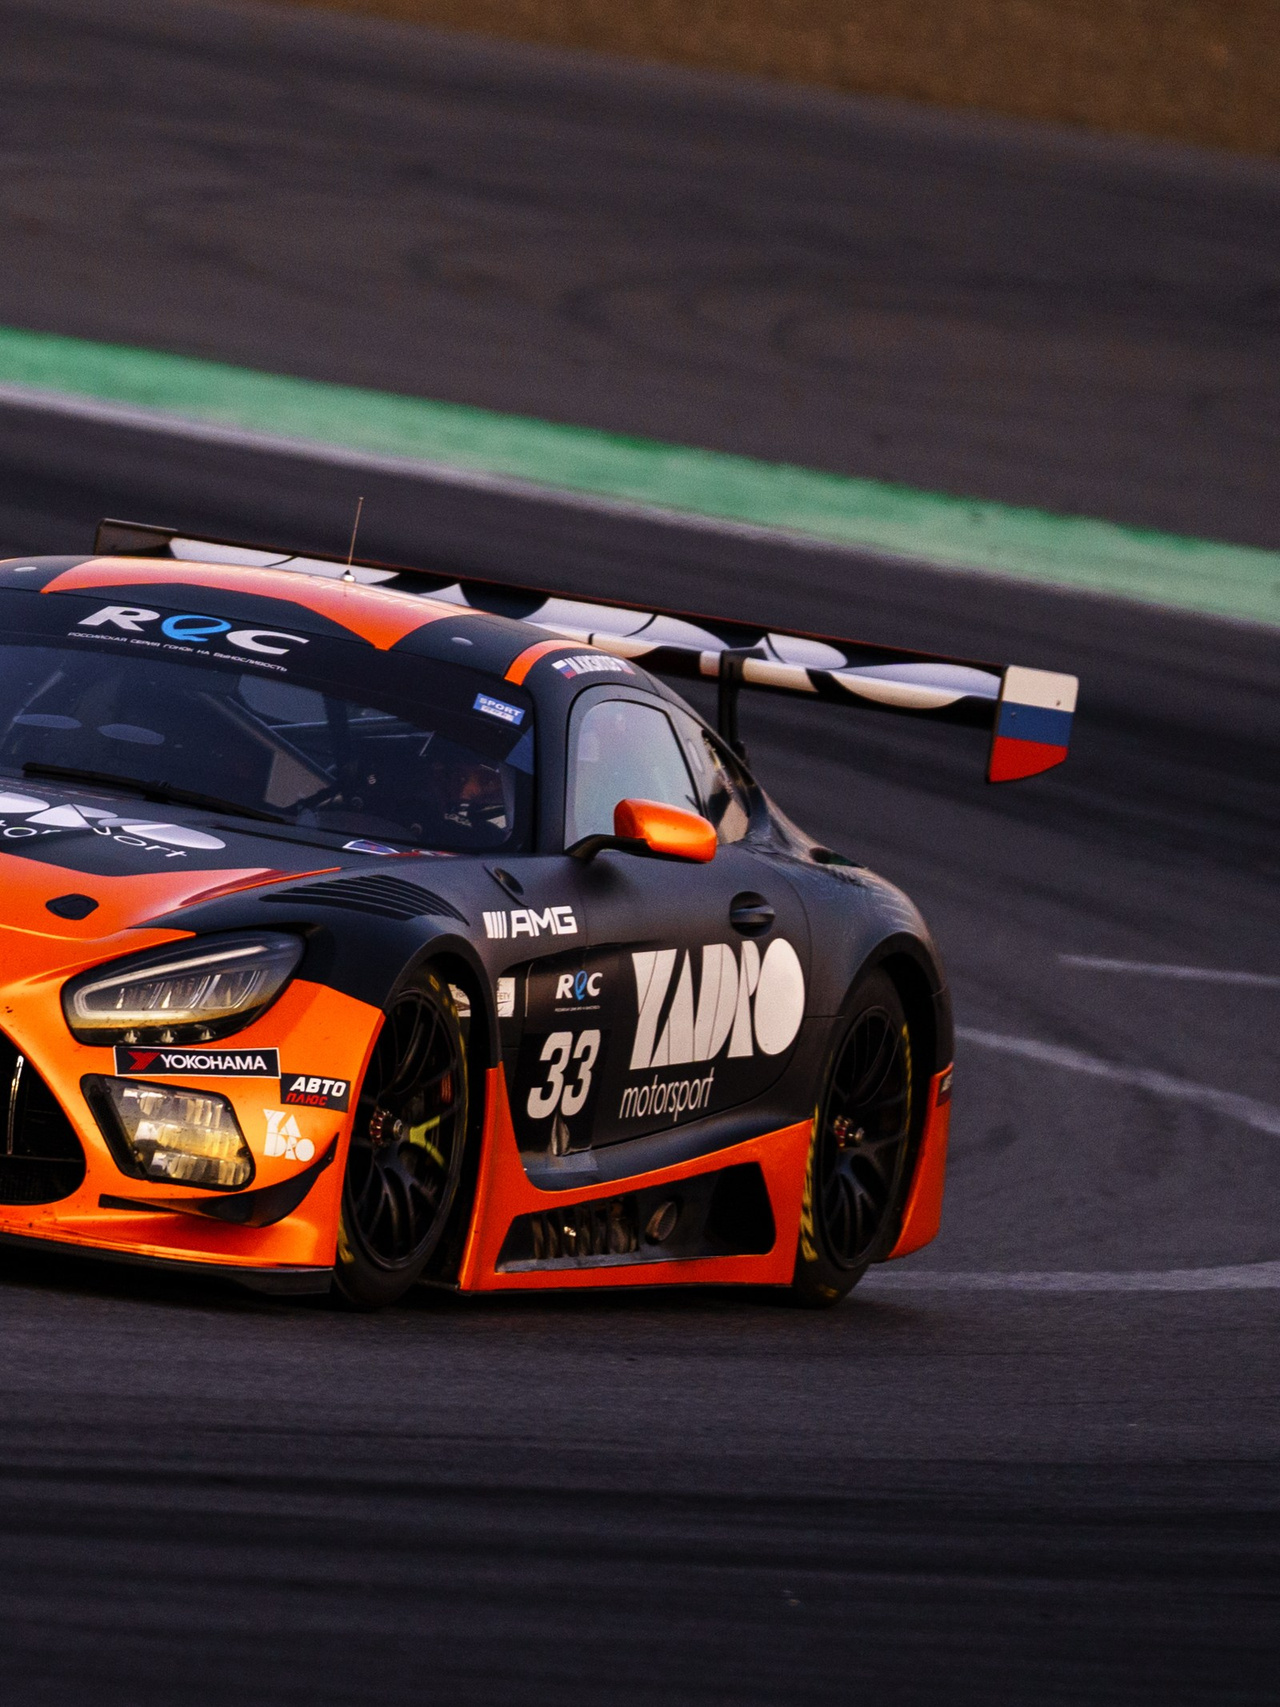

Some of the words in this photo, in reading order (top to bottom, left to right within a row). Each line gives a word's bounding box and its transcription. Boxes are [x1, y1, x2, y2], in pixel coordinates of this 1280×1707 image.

[67, 631, 128, 642] РОССИЙСКАЯ
[130, 638, 161, 647] СЕРИЯ
[163, 643, 195, 652] ГОНОК
[213, 652, 288, 672] ВЫНОСЛИВОСТЬ
[479, 697, 522, 716] SPORT
[629, 938, 805, 1070] YADRO
[160, 1054, 267, 1071] YOKOHAMA
[527, 1029, 600, 1119] 33
[286, 1092, 328, 1106] ПЛЮС
[290, 1076, 347, 1098] АВТО
[619, 1067, 714, 1122] motorsport
